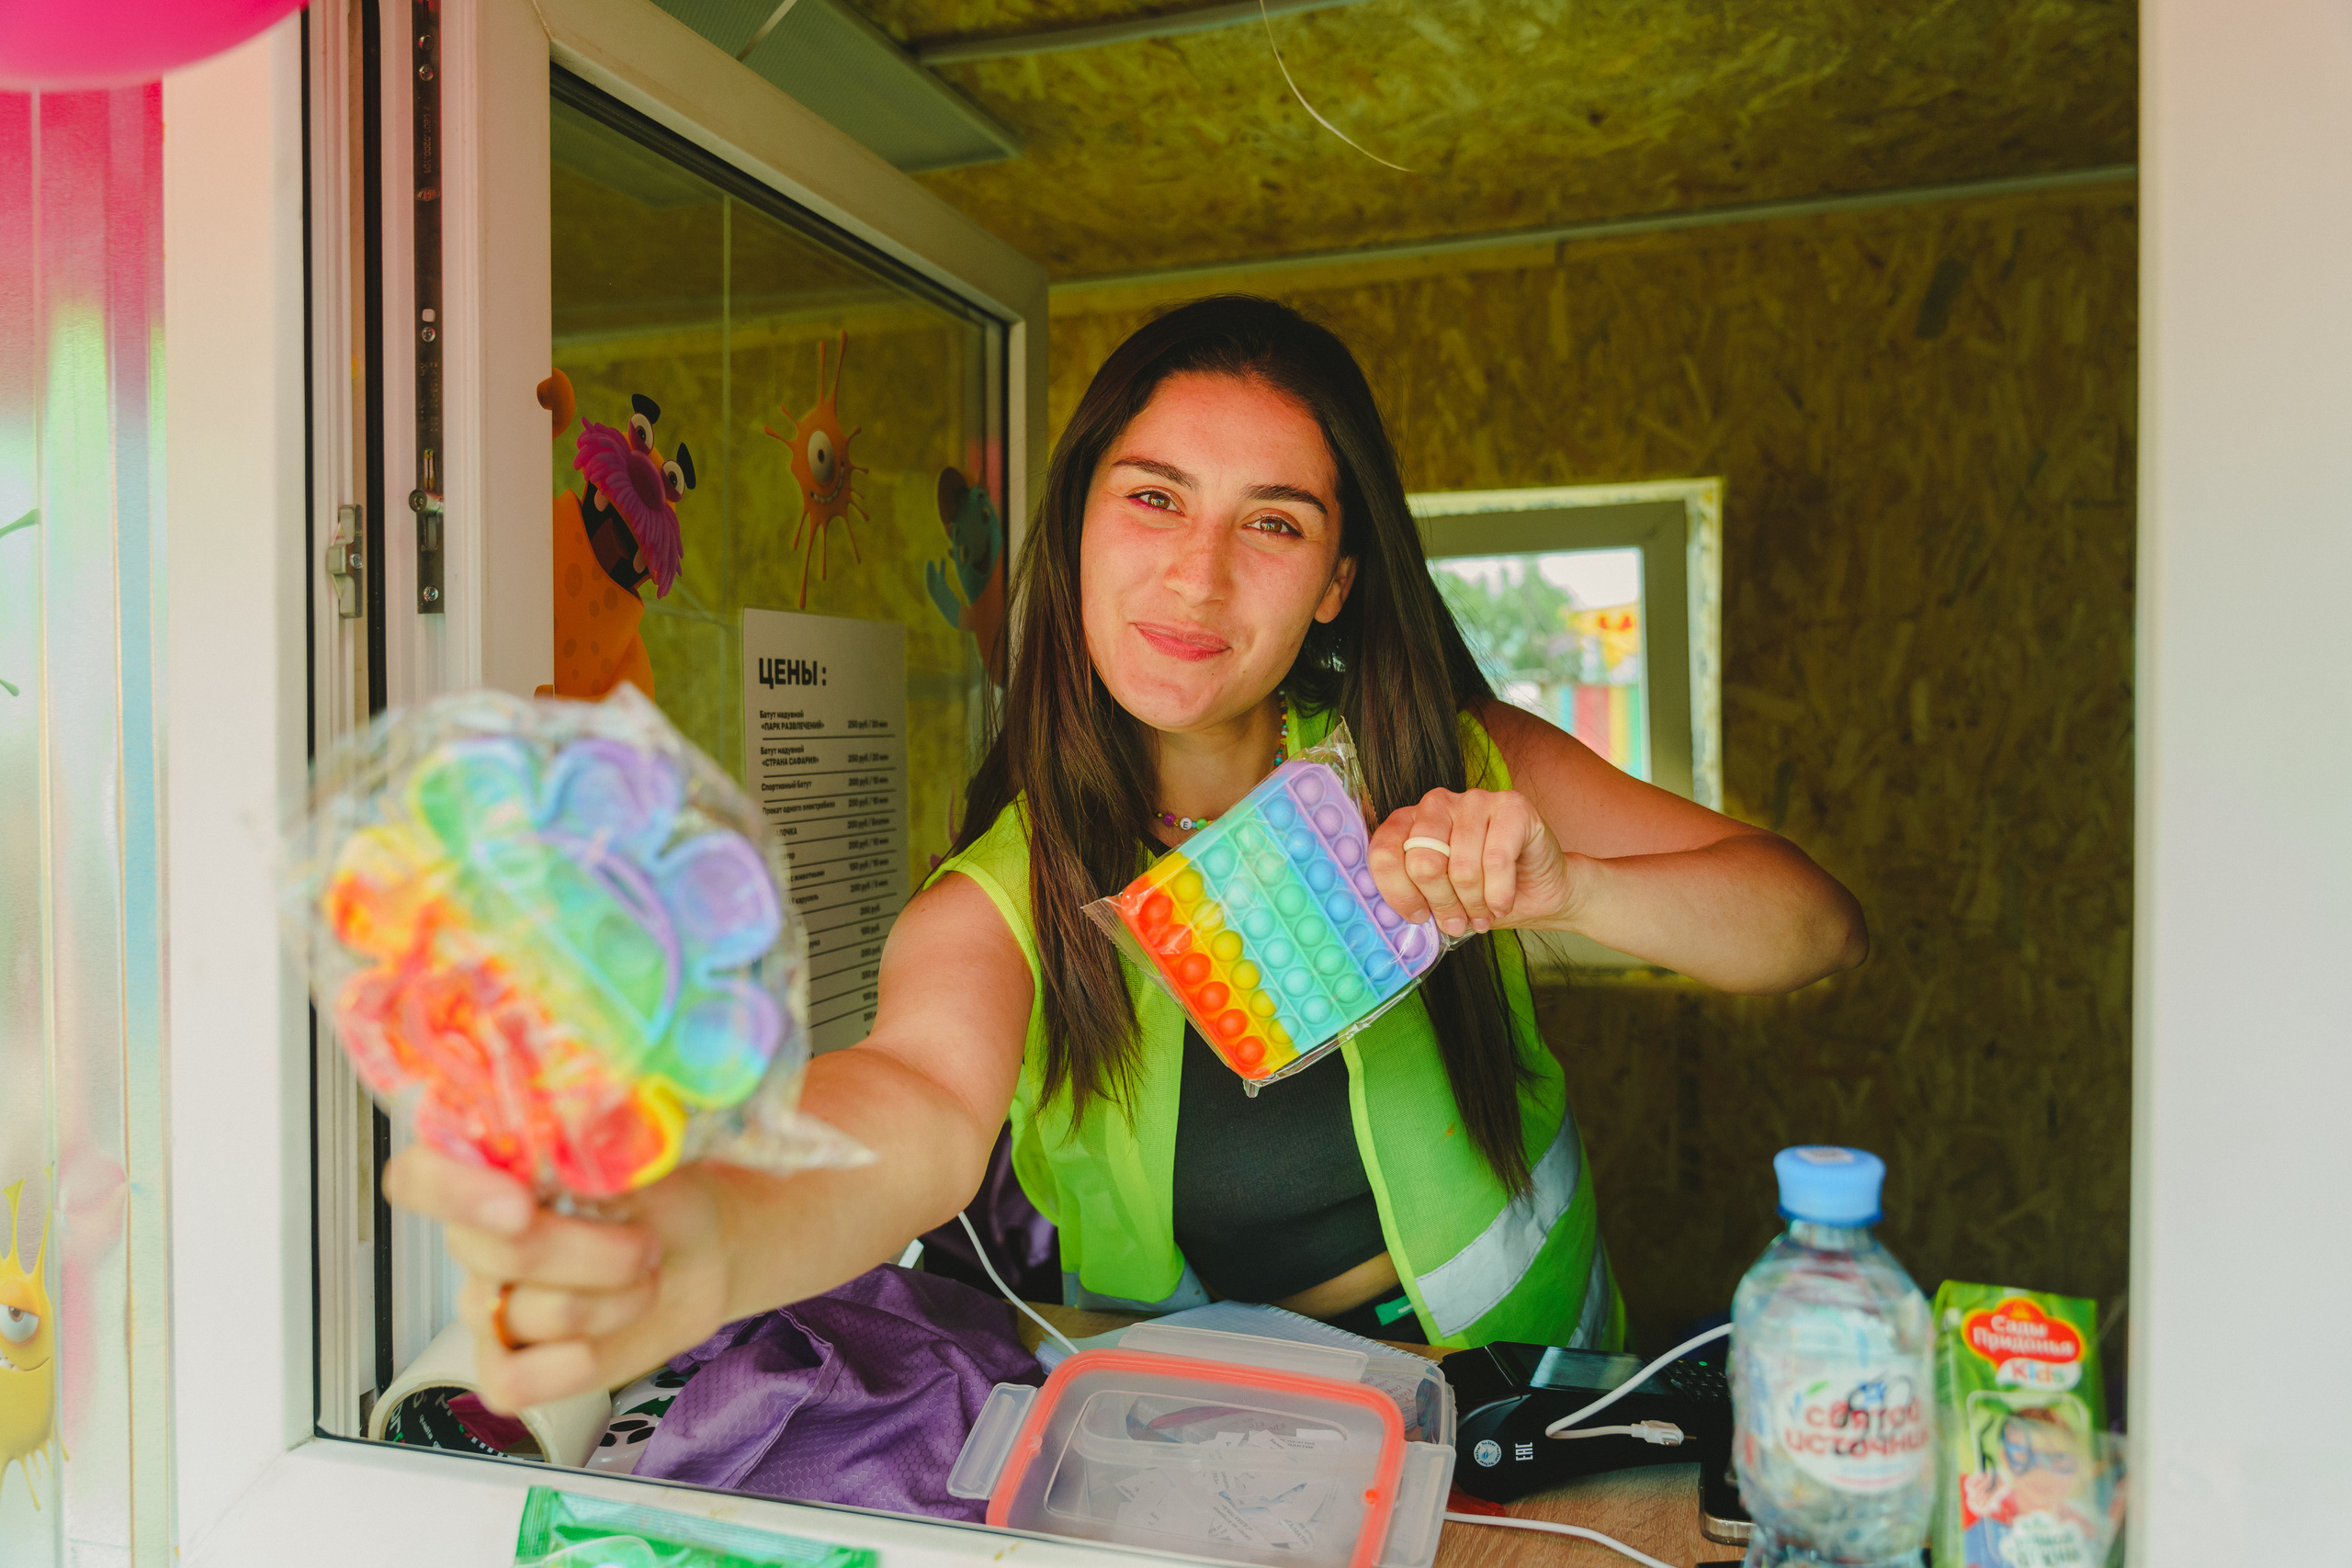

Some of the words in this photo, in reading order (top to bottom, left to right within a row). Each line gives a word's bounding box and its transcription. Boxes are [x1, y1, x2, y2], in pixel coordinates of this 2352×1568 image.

[760, 710, 776, 720] Батут
[777, 709, 805, 720] надувной
[762, 722, 780, 730] «ПАРК
[781, 720, 825, 730] РАЗВЛЕЧЕНИЙ»
[761, 747, 777, 756] Батут
[777, 745, 805, 755] надувной
[762, 758, 787, 767] «СТРАНА
[762, 781, 796, 792] Спортивный
[797, 780, 812, 790] батут
[763, 807, 783, 816] Прокат
[783, 805, 802, 814] одного
[1182, 821, 1190, 829] E
[796, 894, 820, 905] карусель
[1990, 1314, 2049, 1338] Сады
[1973, 1326, 2075, 1357] Придонья
[2011, 1359, 2066, 1383] Kids
